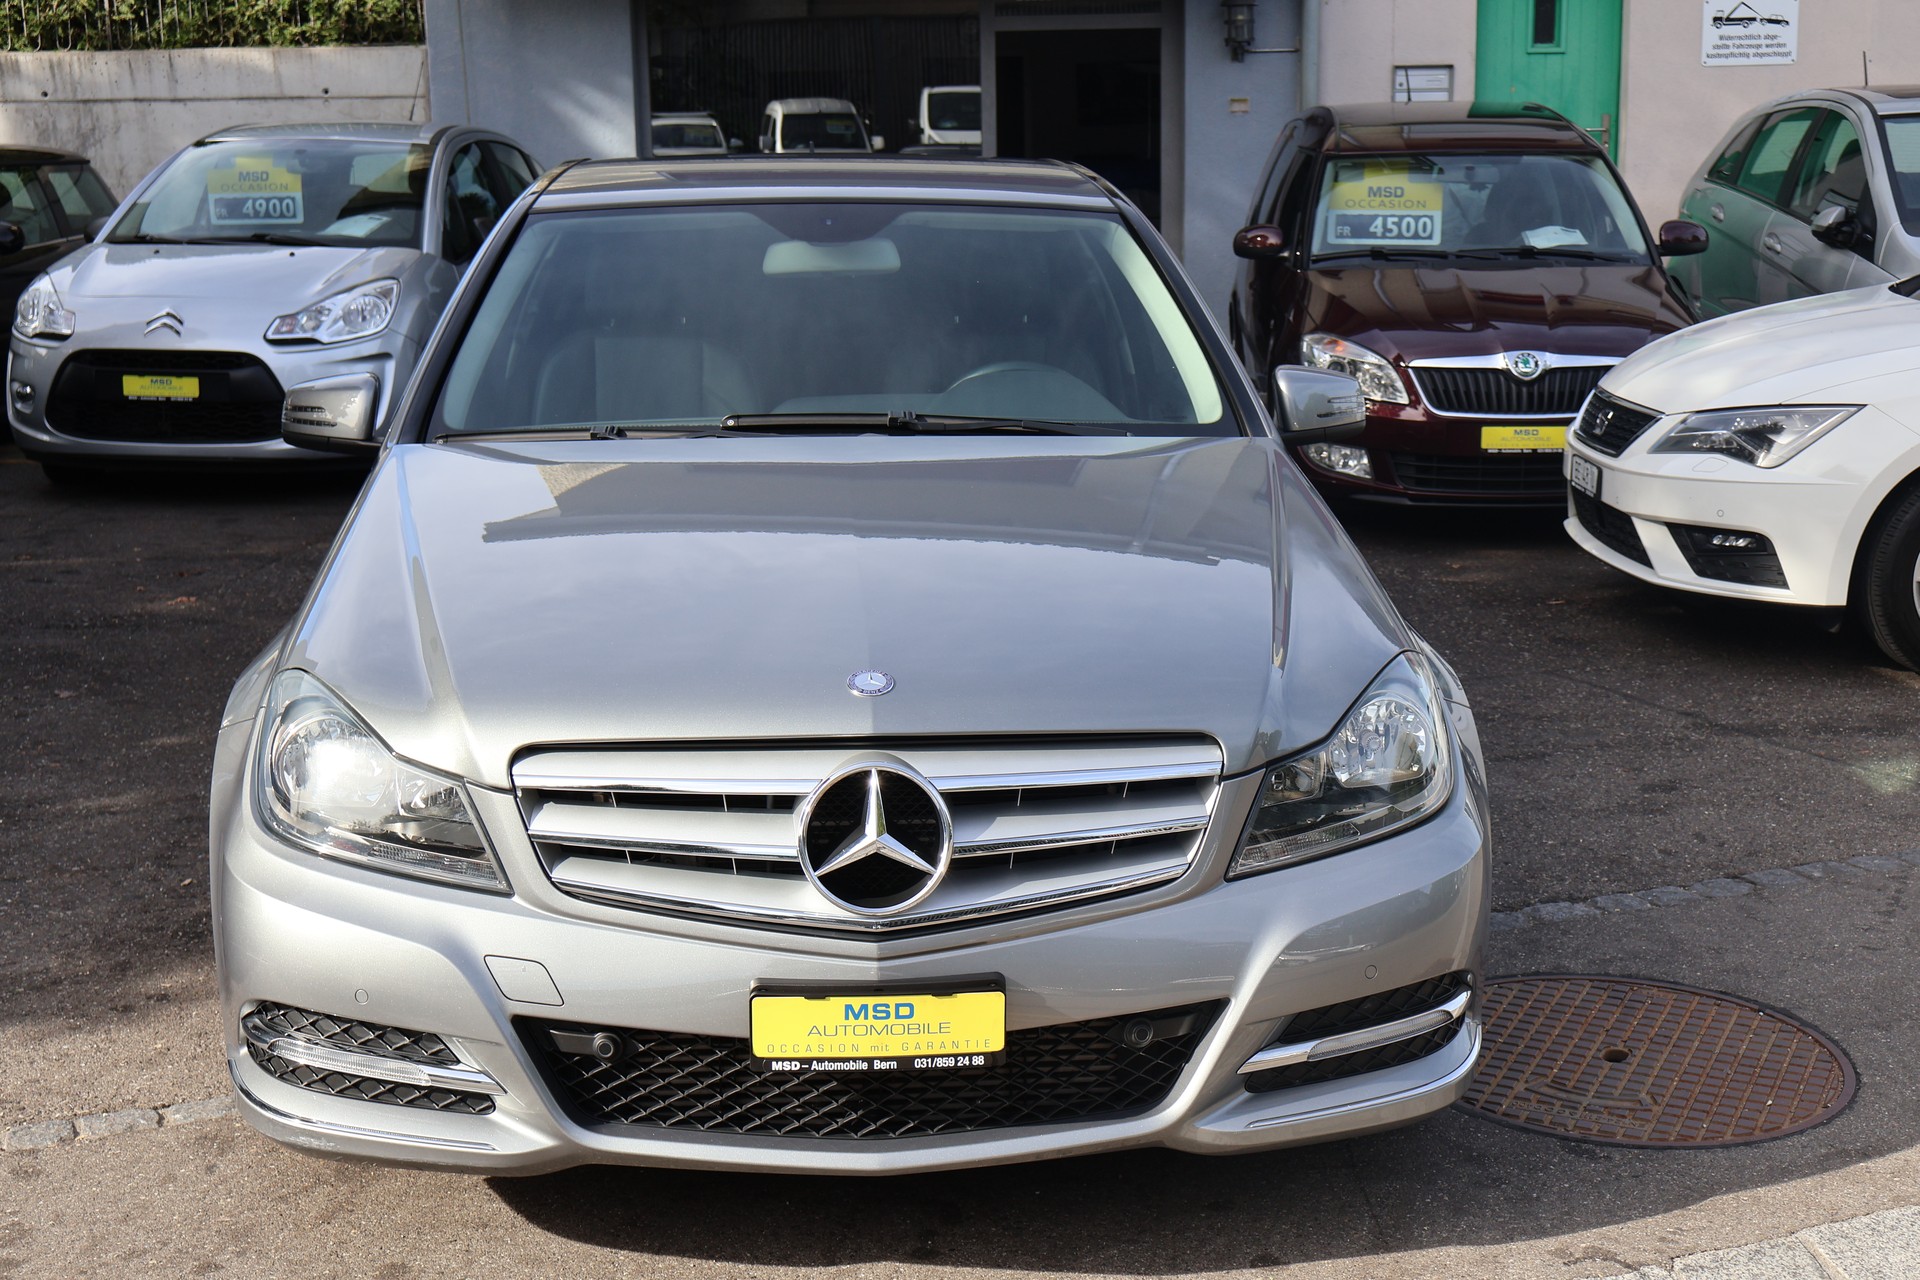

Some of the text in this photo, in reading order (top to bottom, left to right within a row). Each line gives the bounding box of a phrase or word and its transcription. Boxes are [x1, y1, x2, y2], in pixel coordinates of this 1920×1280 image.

[238, 170, 269, 182] MSD
[220, 183, 289, 193] OCCASION
[1367, 186, 1405, 198] MSD
[242, 198, 294, 217] 4900
[1344, 199, 1427, 209] OCCASION
[1336, 216, 1432, 238] FR 4500
[844, 1002, 915, 1021] MSD
[807, 1022, 951, 1037] AUTOMOBILE
[767, 1038, 991, 1053] OCCASION mit GARANTIE
[873, 1059, 897, 1070] Bern
[914, 1056, 955, 1069] 031/859
[957, 1056, 970, 1067] 24
[971, 1055, 985, 1066] 88
